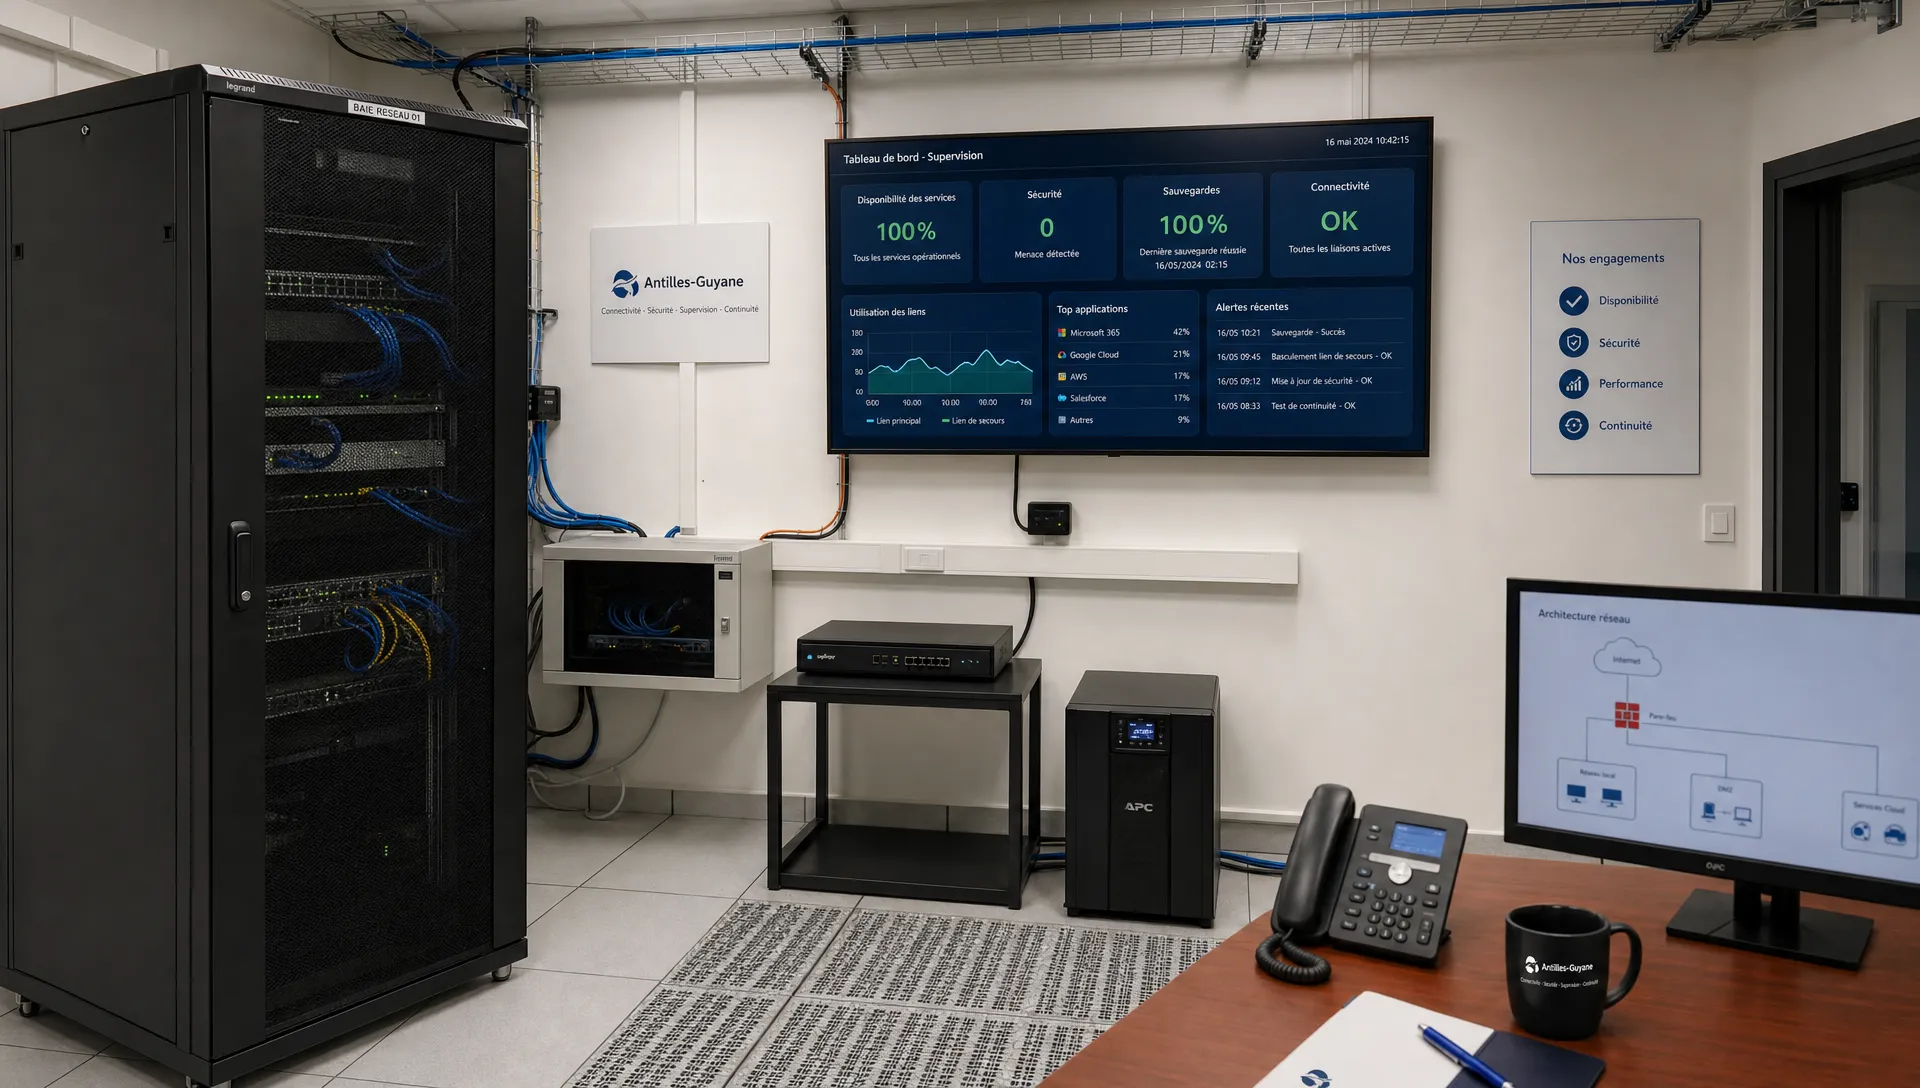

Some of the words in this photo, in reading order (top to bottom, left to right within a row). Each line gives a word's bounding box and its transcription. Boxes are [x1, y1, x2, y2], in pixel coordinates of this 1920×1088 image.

[226, 80, 256, 94] legrand
[353, 103, 374, 114] BAIE
[376, 108, 410, 120] RESEAU
[1326, 138, 1335, 146] 16
[1336, 137, 1352, 146] mai
[1354, 137, 1373, 146] 2024
[1376, 135, 1410, 145] 10:42:15
[843, 154, 880, 164] Tableau
[882, 153, 894, 163] de
[897, 152, 919, 162] bord
[928, 150, 983, 163] Supervision
[1163, 185, 1220, 197] Sauvegardes
[1310, 181, 1370, 192] Connectivité
[1028, 189, 1062, 199] Sécurité
[858, 194, 906, 206] Disponibilité
[908, 194, 922, 203] des
[924, 193, 956, 203] services
[1160, 214, 1228, 235] 100%
[1321, 210, 1358, 231] OK
[877, 221, 936, 241] 100%
[1040, 218, 1054, 237] 0
[1140, 247, 1172, 256] Dernière
[1174, 247, 1218, 257] sauvegarde
[1220, 246, 1246, 255] réussie
[1288, 245, 1315, 253] Toutes
[1317, 244, 1328, 253] les
[1330, 244, 1360, 253] liaisons
[1362, 243, 1391, 252] actives
[882, 253, 910, 262] services
[912, 252, 961, 262] opérationnels
[1014, 250, 1044, 259] Menace
[1046, 249, 1080, 258] détectée
[1562, 253, 1586, 264] Nos
[1590, 253, 1664, 266] engagements
[1155, 260, 1201, 270] 16/05/2024
[1205, 260, 1228, 269] 02:15
[644, 275, 744, 291] Antilles-Guyane
[1600, 295, 1659, 307] Disponibilité
[601, 306, 642, 315] Connectivité
[647, 306, 674, 315] Sécurité
[680, 305, 718, 315] Supervision
[850, 308, 890, 317] Utilisation
[891, 308, 906, 316] des
[908, 307, 926, 316] liens
[1056, 305, 1073, 316] Top
[1075, 304, 1128, 315] applications
[1216, 303, 1248, 312] Alertes
[1250, 302, 1289, 311] récentes
[1070, 328, 1104, 337] Microsoft
[1107, 328, 1120, 337] 365
[1218, 329, 1238, 337] 16/05
[1241, 328, 1260, 337] 10:21
[1272, 328, 1314, 338] Sauvegarde
[1321, 327, 1346, 336] Succès
[1600, 337, 1640, 348] Sécurité
[1070, 351, 1096, 361] Google
[1240, 352, 1261, 361] 09:45
[1272, 352, 1317, 361] Basculement
[1334, 352, 1344, 360] de
[1380, 351, 1392, 360] OK
[1070, 372, 1088, 381] AWS
[1217, 377, 1238, 386] 16/05
[1296, 377, 1311, 387] jour
[1324, 376, 1353, 385] sécurité
[1360, 376, 1372, 385] OK
[1600, 378, 1664, 389] Performance
[1070, 394, 1106, 402] Salesforce
[1174, 393, 1190, 402] 17%
[1299, 401, 1336, 410] continuité
[1344, 401, 1356, 410] OK
[892, 417, 921, 426] principal
[1178, 415, 1190, 424] 9%
[1599, 420, 1652, 431] Continuité
[1538, 609, 1596, 622] Architecture
[1599, 613, 1630, 624] réseau
[1125, 802, 1153, 812] APC
[1542, 963, 1593, 973] Antilles-Guyane
